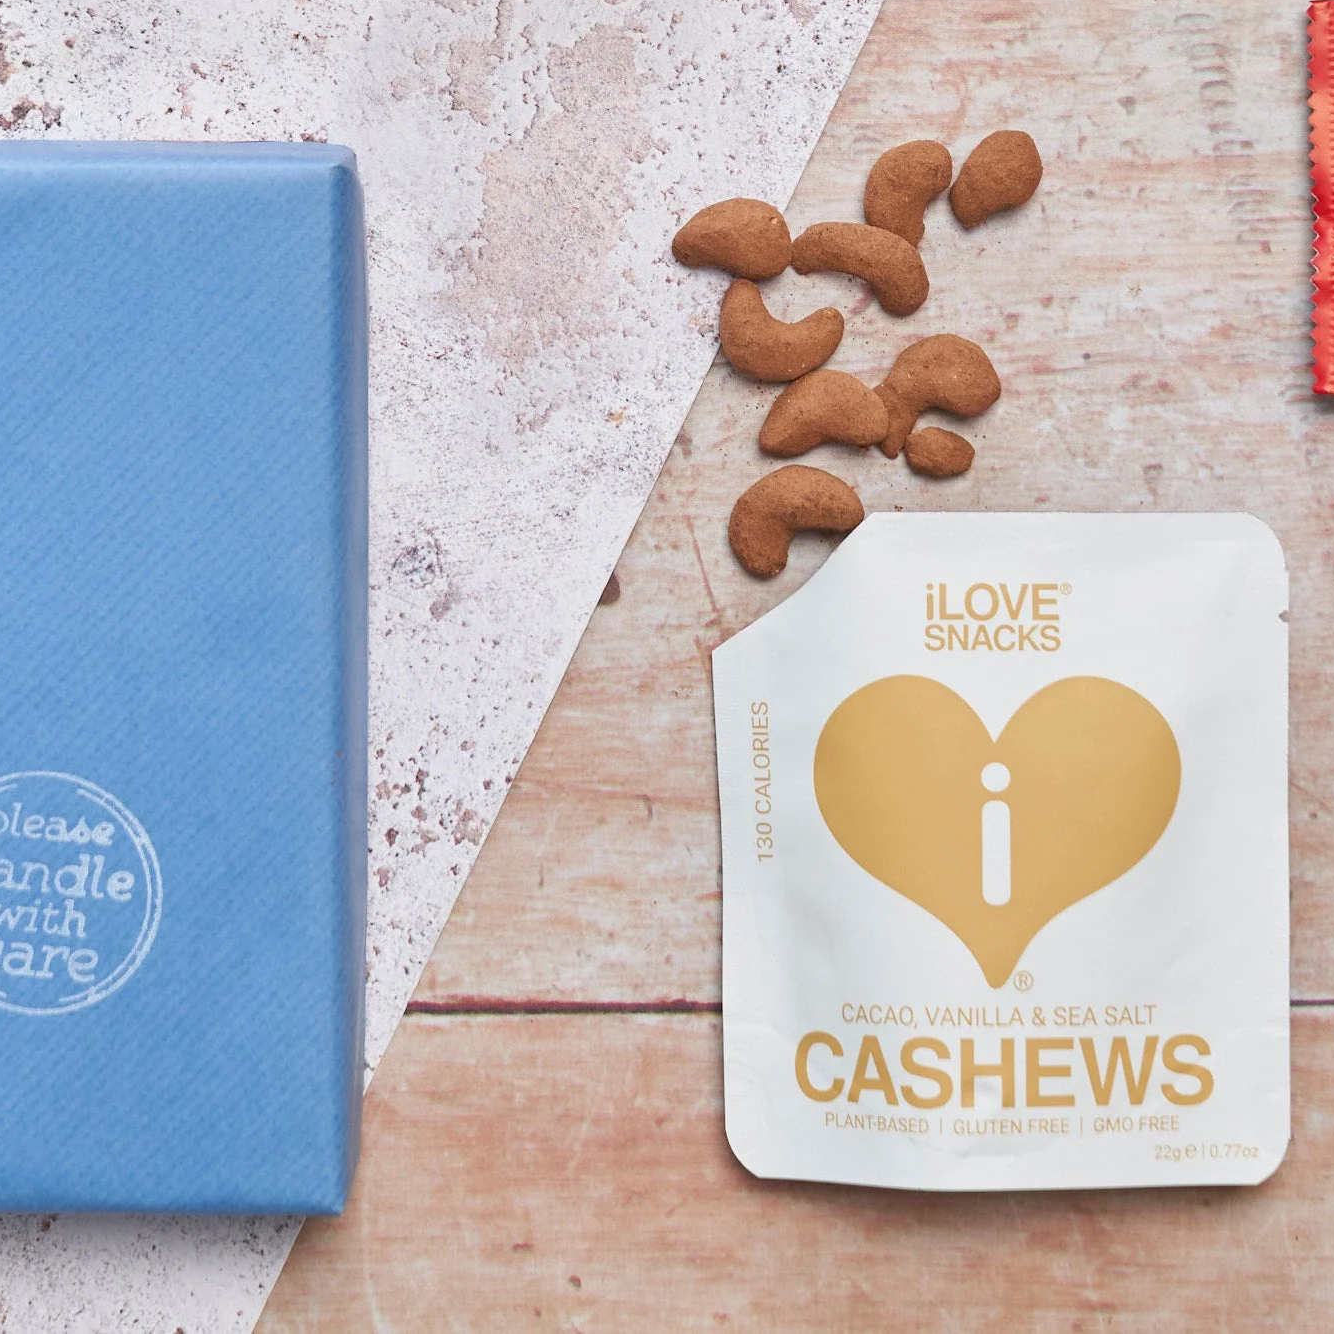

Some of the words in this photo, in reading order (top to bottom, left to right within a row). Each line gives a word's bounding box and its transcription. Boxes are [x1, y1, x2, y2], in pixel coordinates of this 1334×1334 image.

[924, 623, 1061, 652] SNACKS
[751, 701, 772, 815] CALORIES
[756, 822, 774, 862] 130
[841, 1002, 918, 1029] CACAO,
[925, 1006, 1024, 1027] VANILLA
[1032, 1006, 1047, 1027] &
[1053, 1005, 1098, 1027] SEA
[1104, 1004, 1158, 1025] SALT
[794, 1030, 1216, 1109] CASHEWS
[825, 1111, 930, 1134] PLANT-BASED
[953, 1119, 1023, 1135] GLUTEN
[1028, 1118, 1070, 1134] FREE
[1093, 1117, 1134, 1133] GMO
[1139, 1115, 1180, 1131] FREE
[1155, 1145, 1181, 1162] 22g
